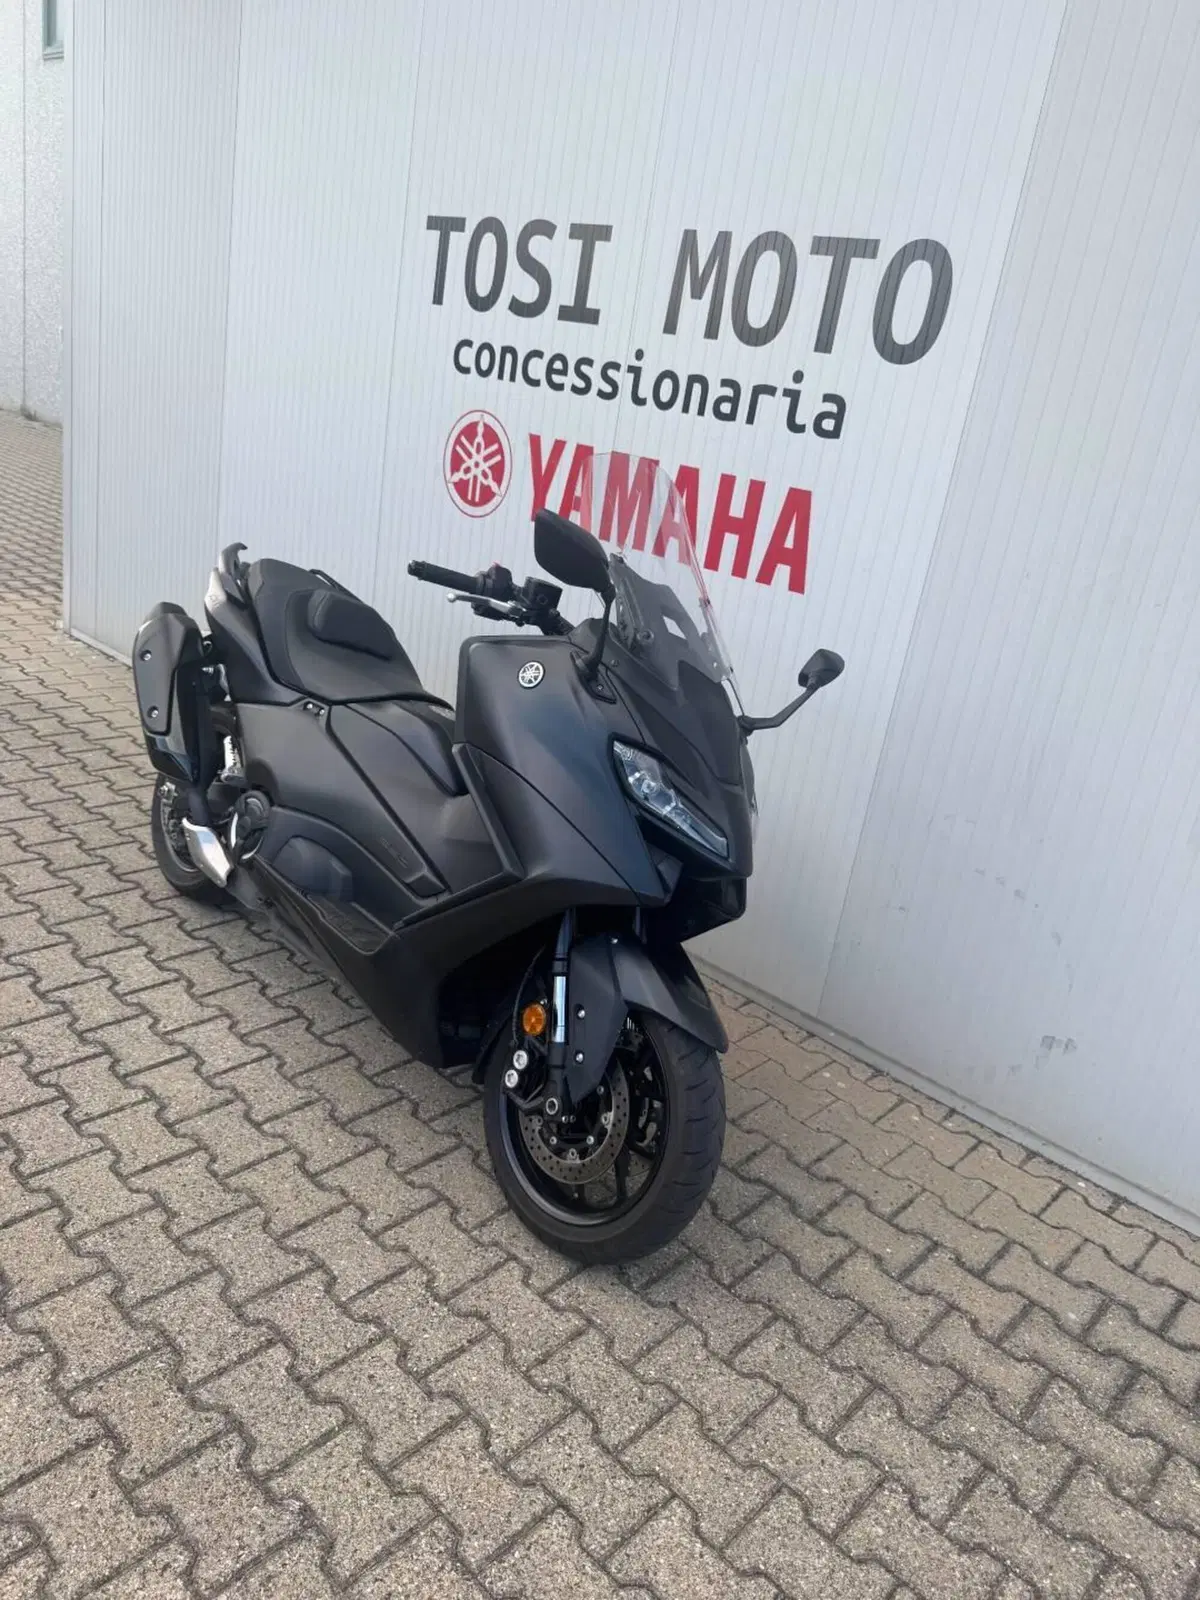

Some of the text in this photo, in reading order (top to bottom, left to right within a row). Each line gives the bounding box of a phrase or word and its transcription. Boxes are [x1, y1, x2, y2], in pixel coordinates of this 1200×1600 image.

[426, 215, 953, 365] TOSI MOTO
[452, 338, 847, 440] concessionaria
[528, 433, 813, 595] YAMAHA
